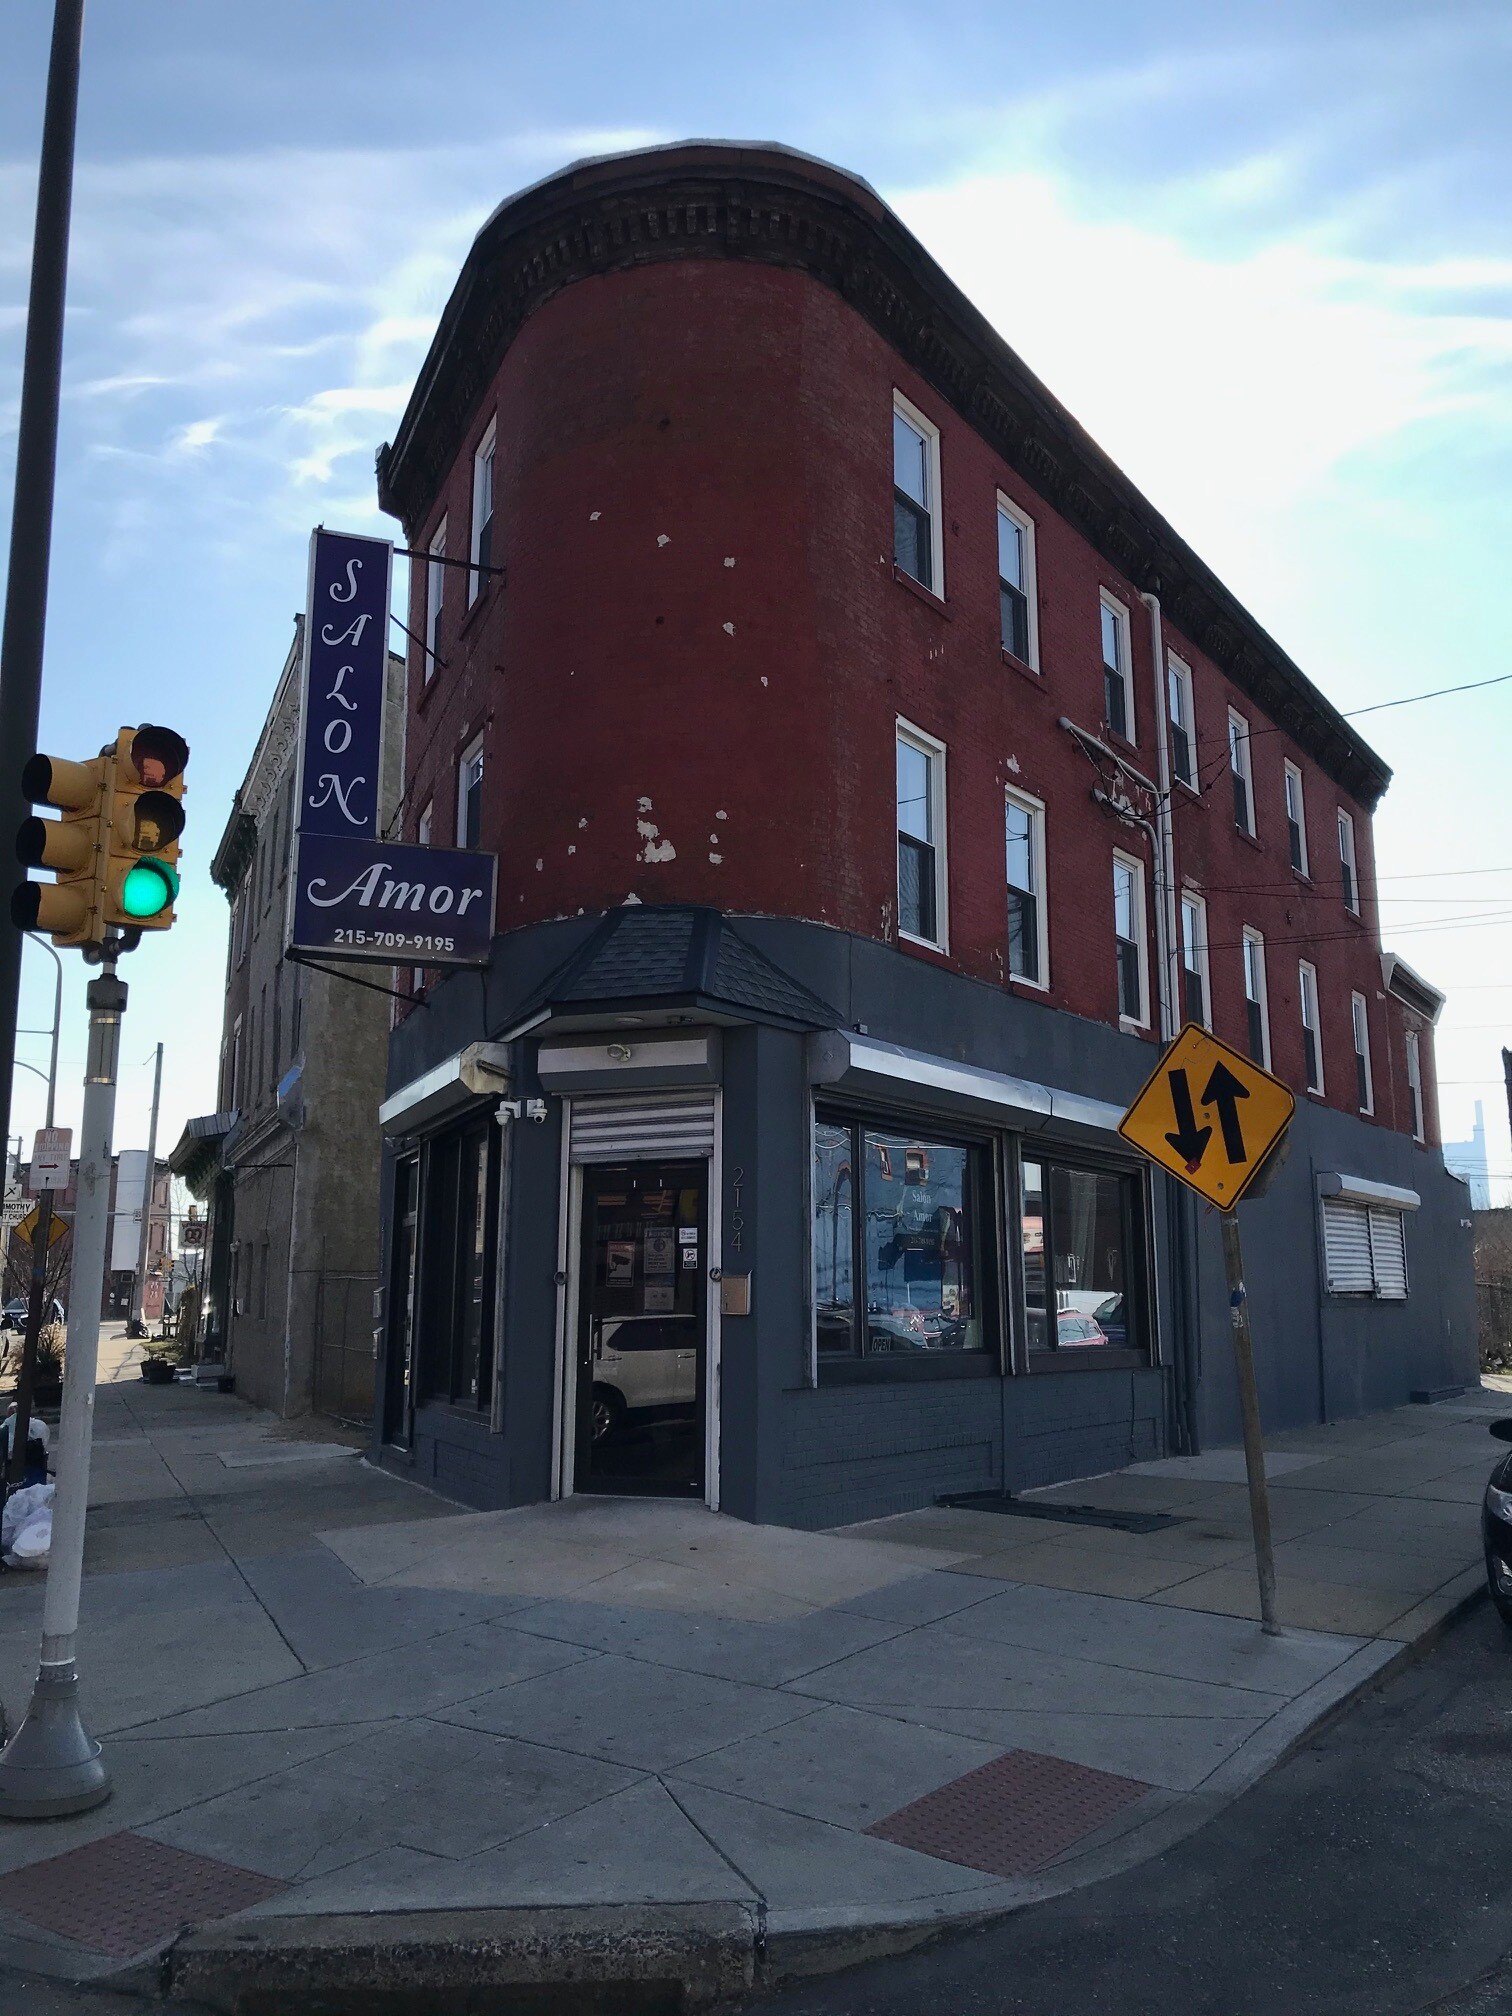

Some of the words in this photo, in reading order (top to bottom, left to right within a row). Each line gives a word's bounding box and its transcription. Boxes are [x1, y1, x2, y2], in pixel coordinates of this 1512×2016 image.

[309, 558, 373, 826] SALON
[307, 862, 484, 916] Amor
[333, 928, 455, 952] 215-709-9195
[45, 1131, 58, 1142] NO
[912, 1189, 932, 1204] Salon
[5, 1203, 31, 1212] MOTHY
[731, 1166, 745, 1253] 2154
[913, 1210, 933, 1223] Amor
[873, 1338, 892, 1351] OPEN
